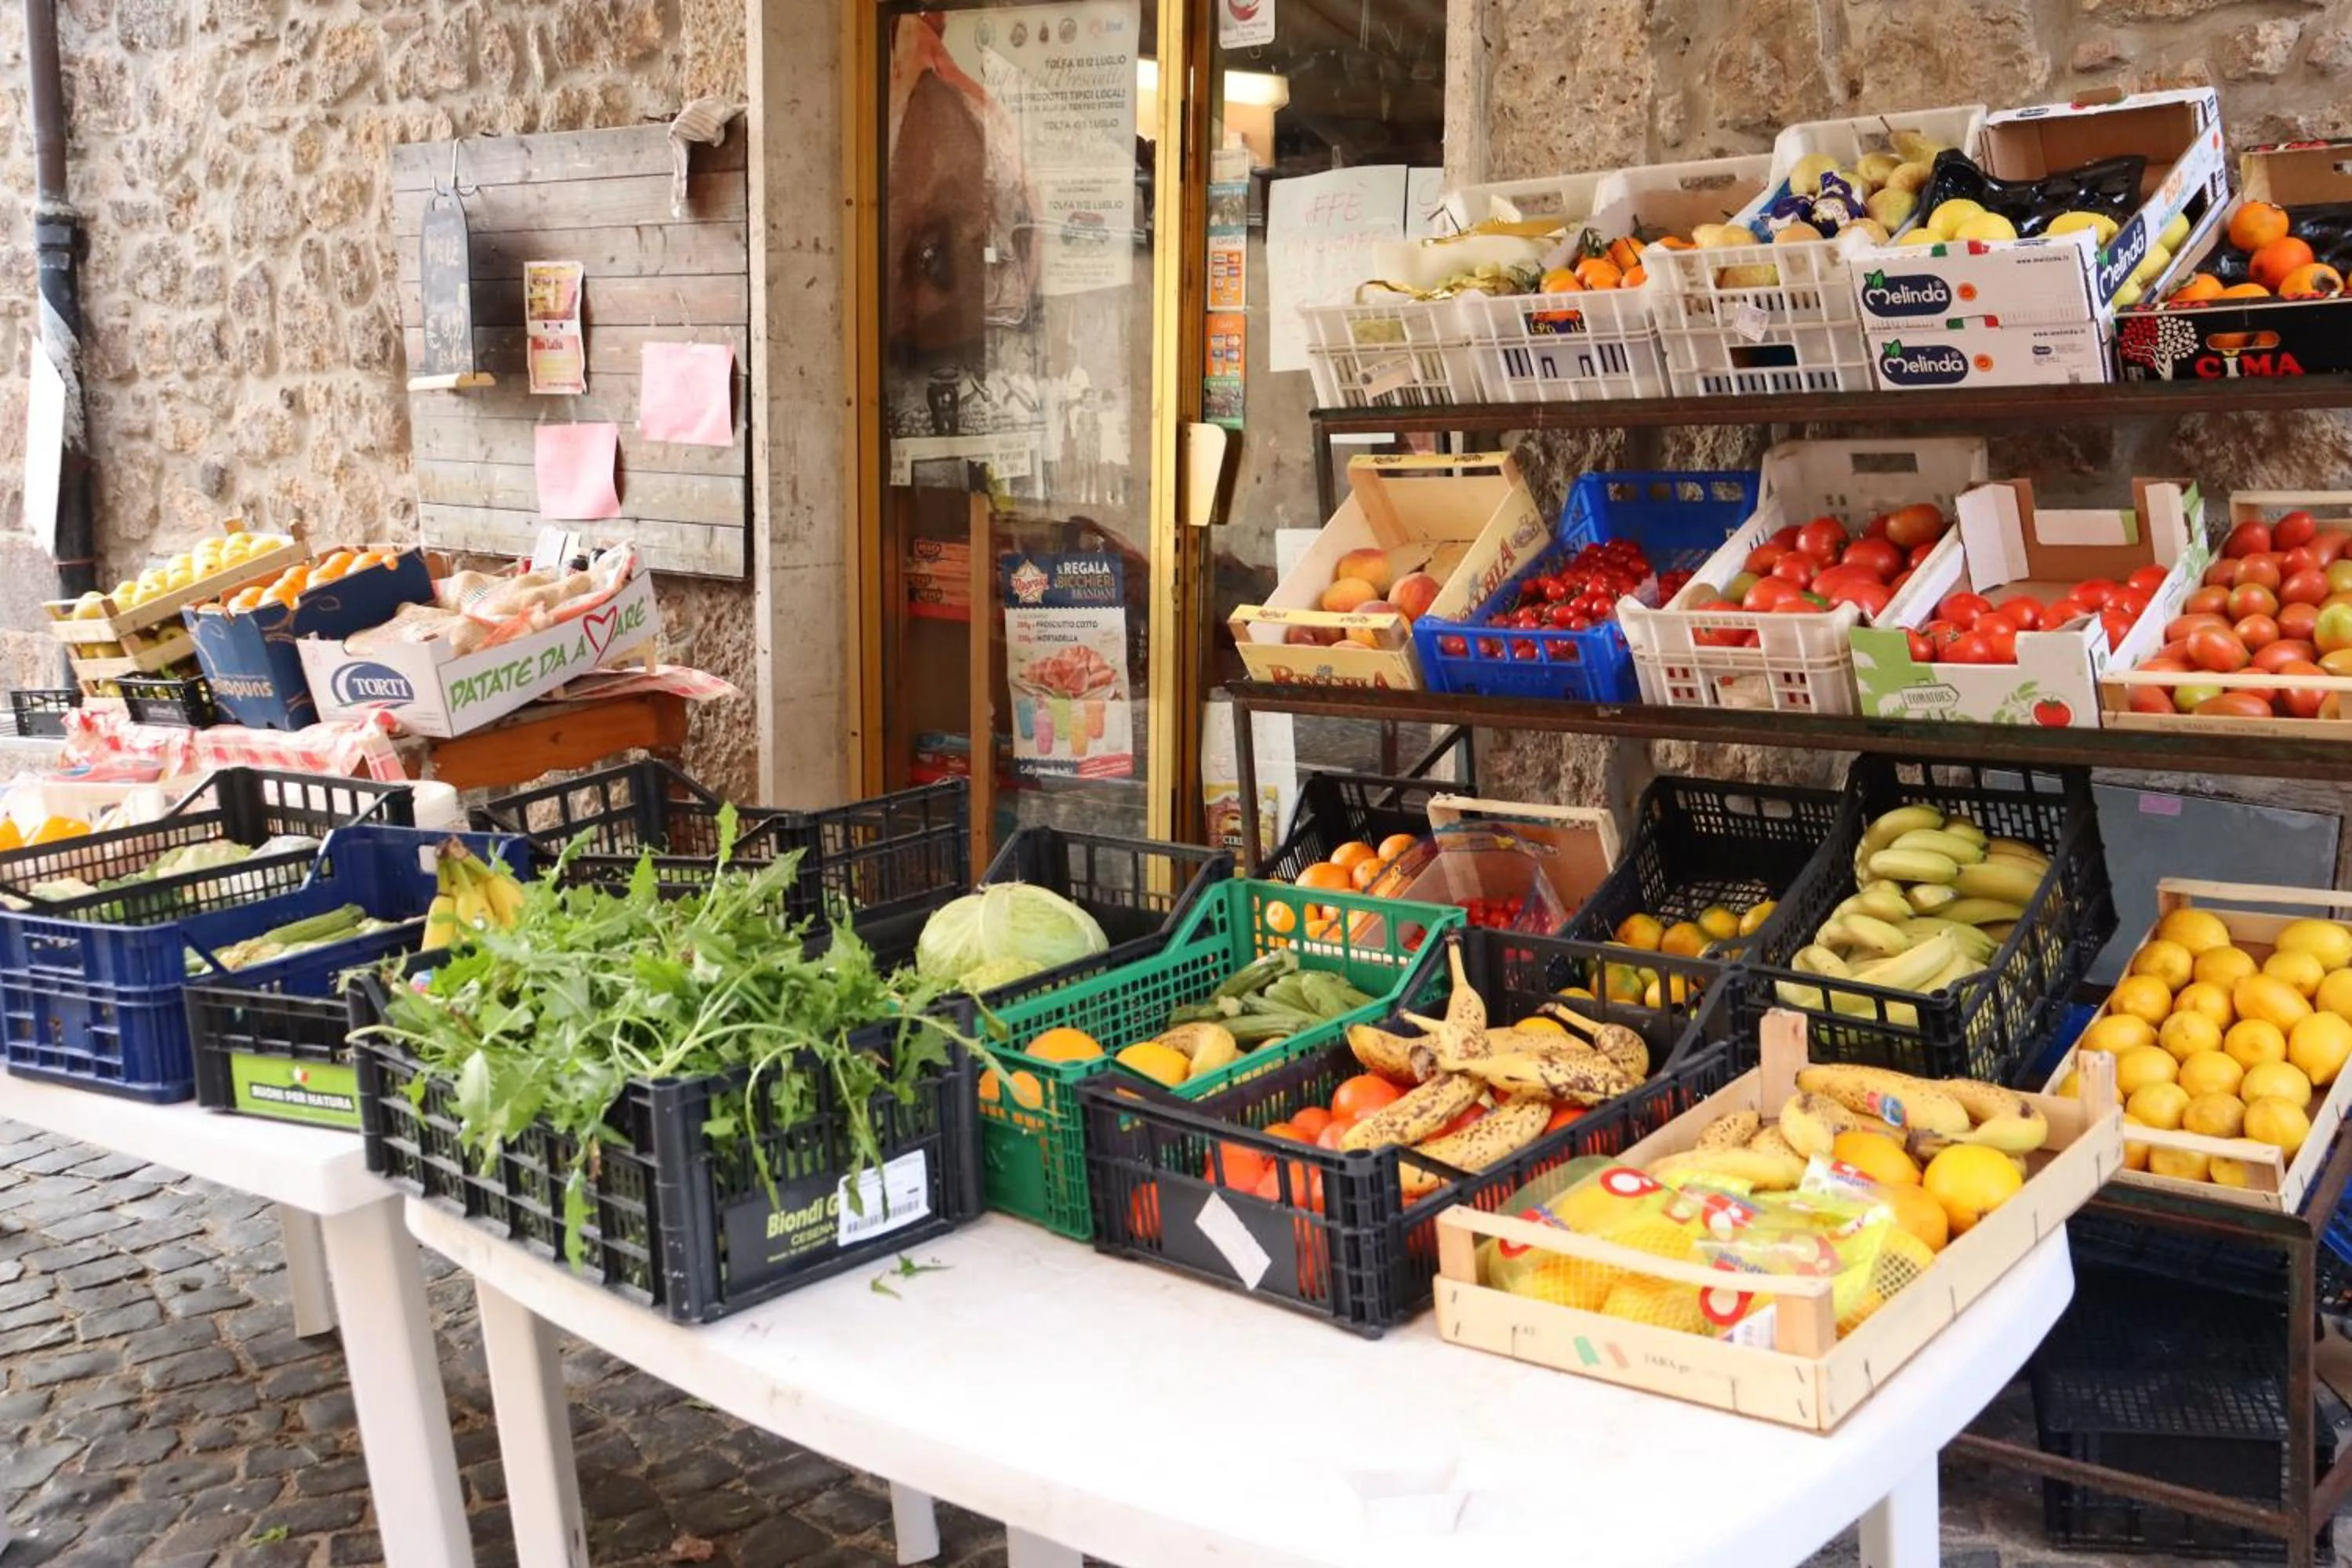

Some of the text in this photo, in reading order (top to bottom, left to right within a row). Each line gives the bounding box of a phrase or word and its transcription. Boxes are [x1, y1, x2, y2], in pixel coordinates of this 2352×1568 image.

[1096, 54, 1127, 65] LUGLIO
[2099, 234, 2145, 299] Melinda
[1865, 282, 1950, 307] Melinda
[1883, 354, 1965, 374] Melinda
[2195, 350, 2305, 378] CIMA
[1064, 561, 1111, 574] REGALA
[1058, 574, 1115, 588] BICCHIERI
[352, 678, 409, 697] TORTI
[448, 655, 534, 713] PATATE
[539, 643, 568, 679] DA
[1906, 691, 1954, 704] TOMATOES
[307, 1093, 352, 1109] NATURA
[767, 1195, 824, 1239] Biondi
